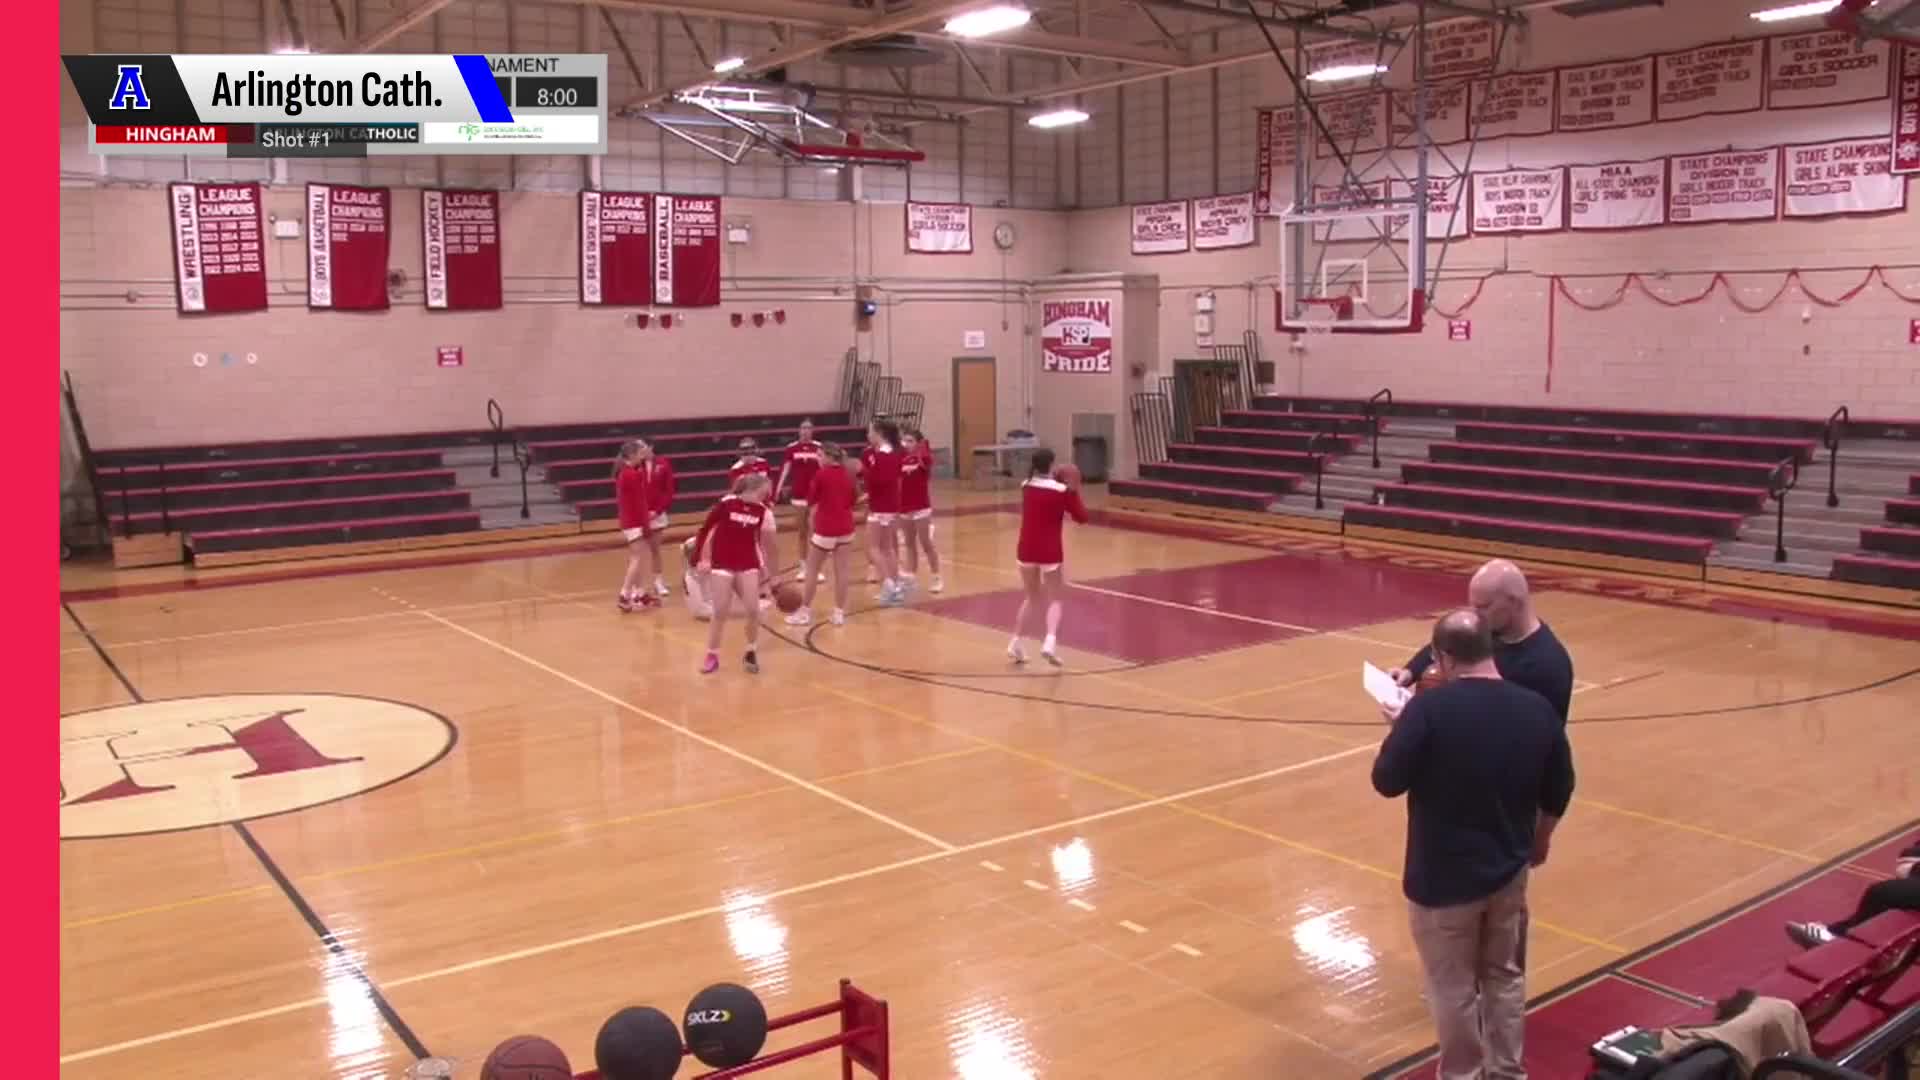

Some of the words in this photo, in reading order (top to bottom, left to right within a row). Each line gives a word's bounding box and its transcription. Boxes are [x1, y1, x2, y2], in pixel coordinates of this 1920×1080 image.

[1778, 63, 1818, 77] GIRLS
[1823, 54, 1879, 72] SOCCER
[1680, 157, 1709, 171] STATE
[1711, 152, 1769, 167] CHAMPIONS
[1794, 149, 1829, 165] STATE
[1831, 143, 1891, 161] CHAMPION
[1689, 168, 1739, 181] DIVISION
[1794, 166, 1821, 182] GIRLS
[1826, 162, 1859, 179] ALPINE
[1738, 176, 1766, 189] TRACK
[199, 187, 254, 203] LEAGUE
[332, 189, 382, 206] LEAGUE
[445, 193, 493, 207] LEAGUE
[603, 196, 644, 208] LEAGUE
[199, 202, 257, 217] CHAMPIONS
[331, 204, 384, 219] CHAMPIONS
[445, 207, 495, 220] CHAMPIONS
[674, 200, 715, 212] LEAGUE
[428, 196, 442, 242] HOCKEY
[601, 209, 647, 221] CHAMPIONS
[673, 212, 717, 224] CHAMPIONS
[178, 193, 197, 279] WRESTLING
[659, 199, 670, 281] BASEBALL
[430, 244, 443, 279] FIELD
[1043, 301, 1110, 328] HINGHAM
[1043, 348, 1111, 372] PRIDE
